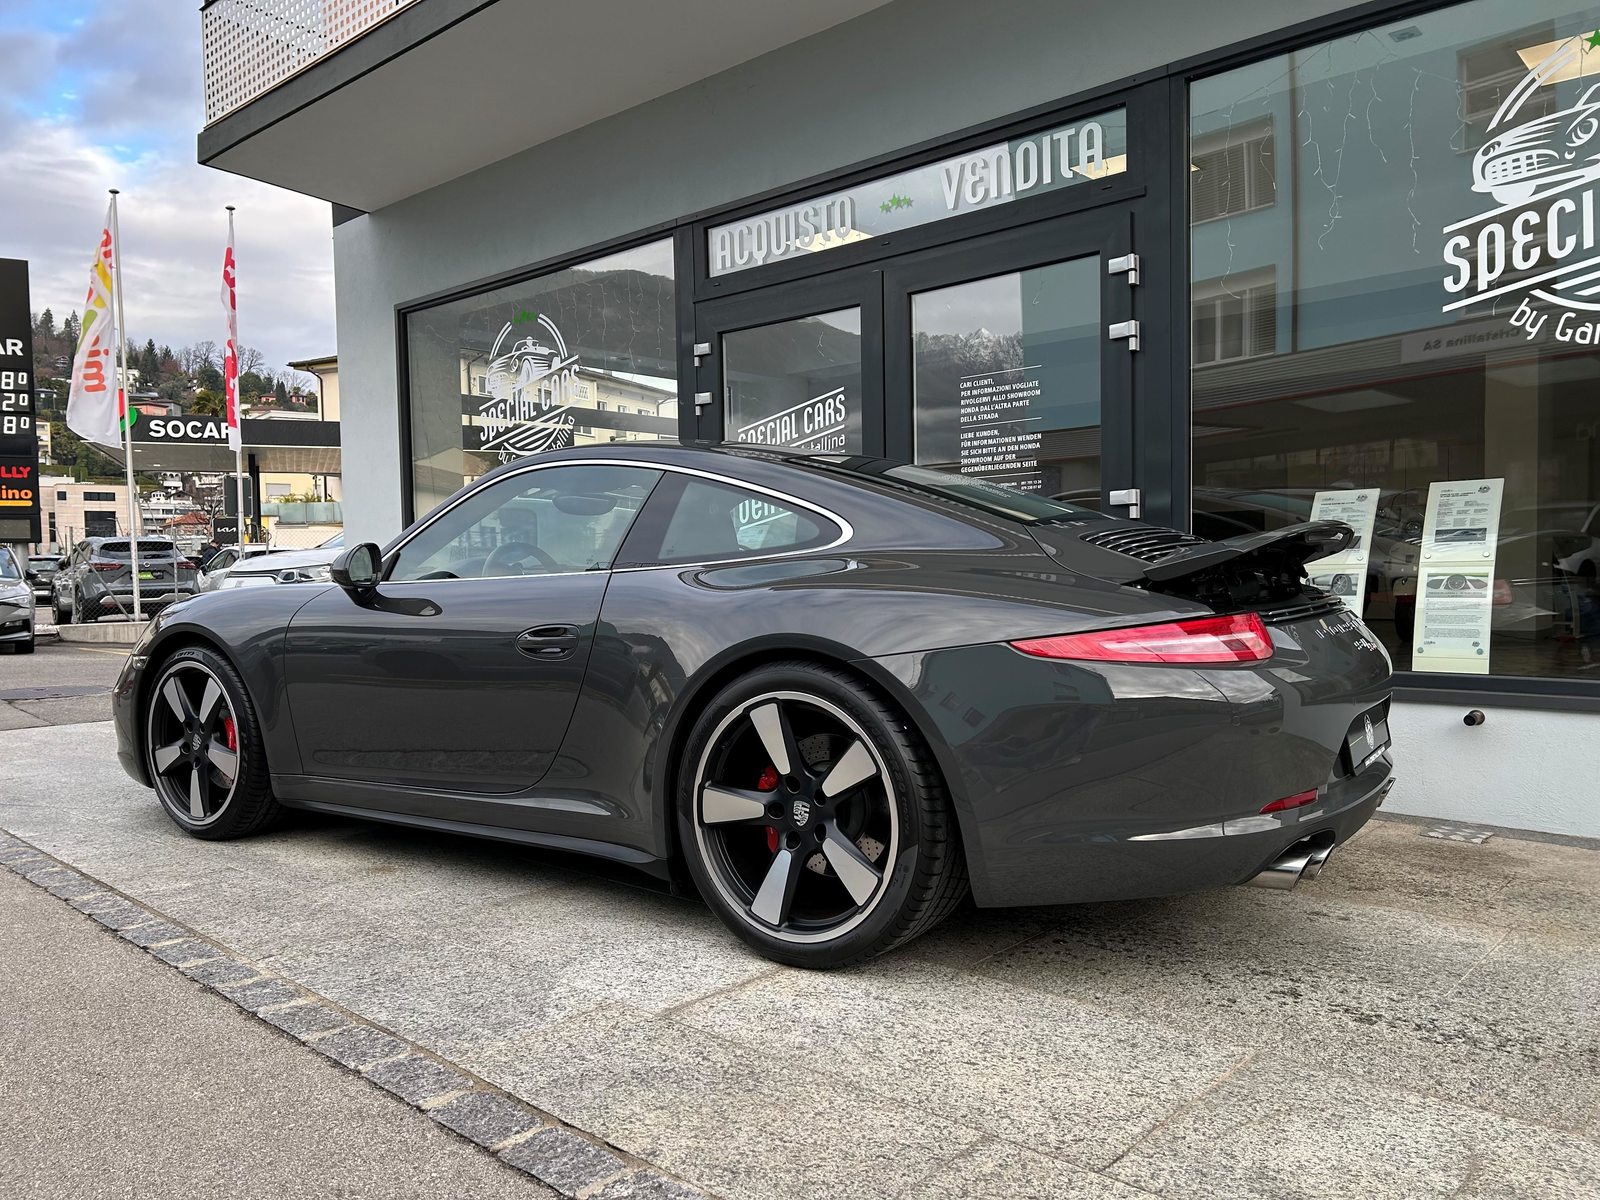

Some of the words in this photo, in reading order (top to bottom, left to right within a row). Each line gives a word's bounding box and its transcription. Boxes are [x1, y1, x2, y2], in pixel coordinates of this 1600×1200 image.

[716, 196, 855, 270] ACQUISTO
[940, 121, 1104, 211] VENDITA
[1508, 297, 1549, 341] by
[541, 364, 580, 411] CARS
[971, 384, 1011, 395] INFORMAZIONI
[1012, 380, 1039, 389] VOGLIATE
[961, 396, 991, 406] RIVOLGERVI
[992, 394, 1006, 402] ALLO
[1007, 389, 1041, 399] SHOWROOM
[803, 393, 846, 434] CARS
[961, 406, 979, 414] HONDA
[1012, 400, 1029, 408] PARTE
[960, 415, 977, 423] DELLA
[978, 412, 999, 421] STRADA
[960, 431, 974, 439] LIEBE
[976, 429, 1000, 438] KUNDEN,
[961, 440, 971, 448] FÜR
[972, 436, 1017, 447] INFORMATIONEN
[1017, 433, 1042, 442] WENDEN
[801, 433, 846, 451] tallina
[1020, 442, 1041, 450] HONDA
[960, 456, 993, 465] SHOWROOM
[993, 454, 1004, 462] AUF
[1004, 453, 1016, 461] DER
[961, 462, 1021, 473] GEGENÜBERLIEGENDEN
[1022, 460, 1038, 468] SEITE
